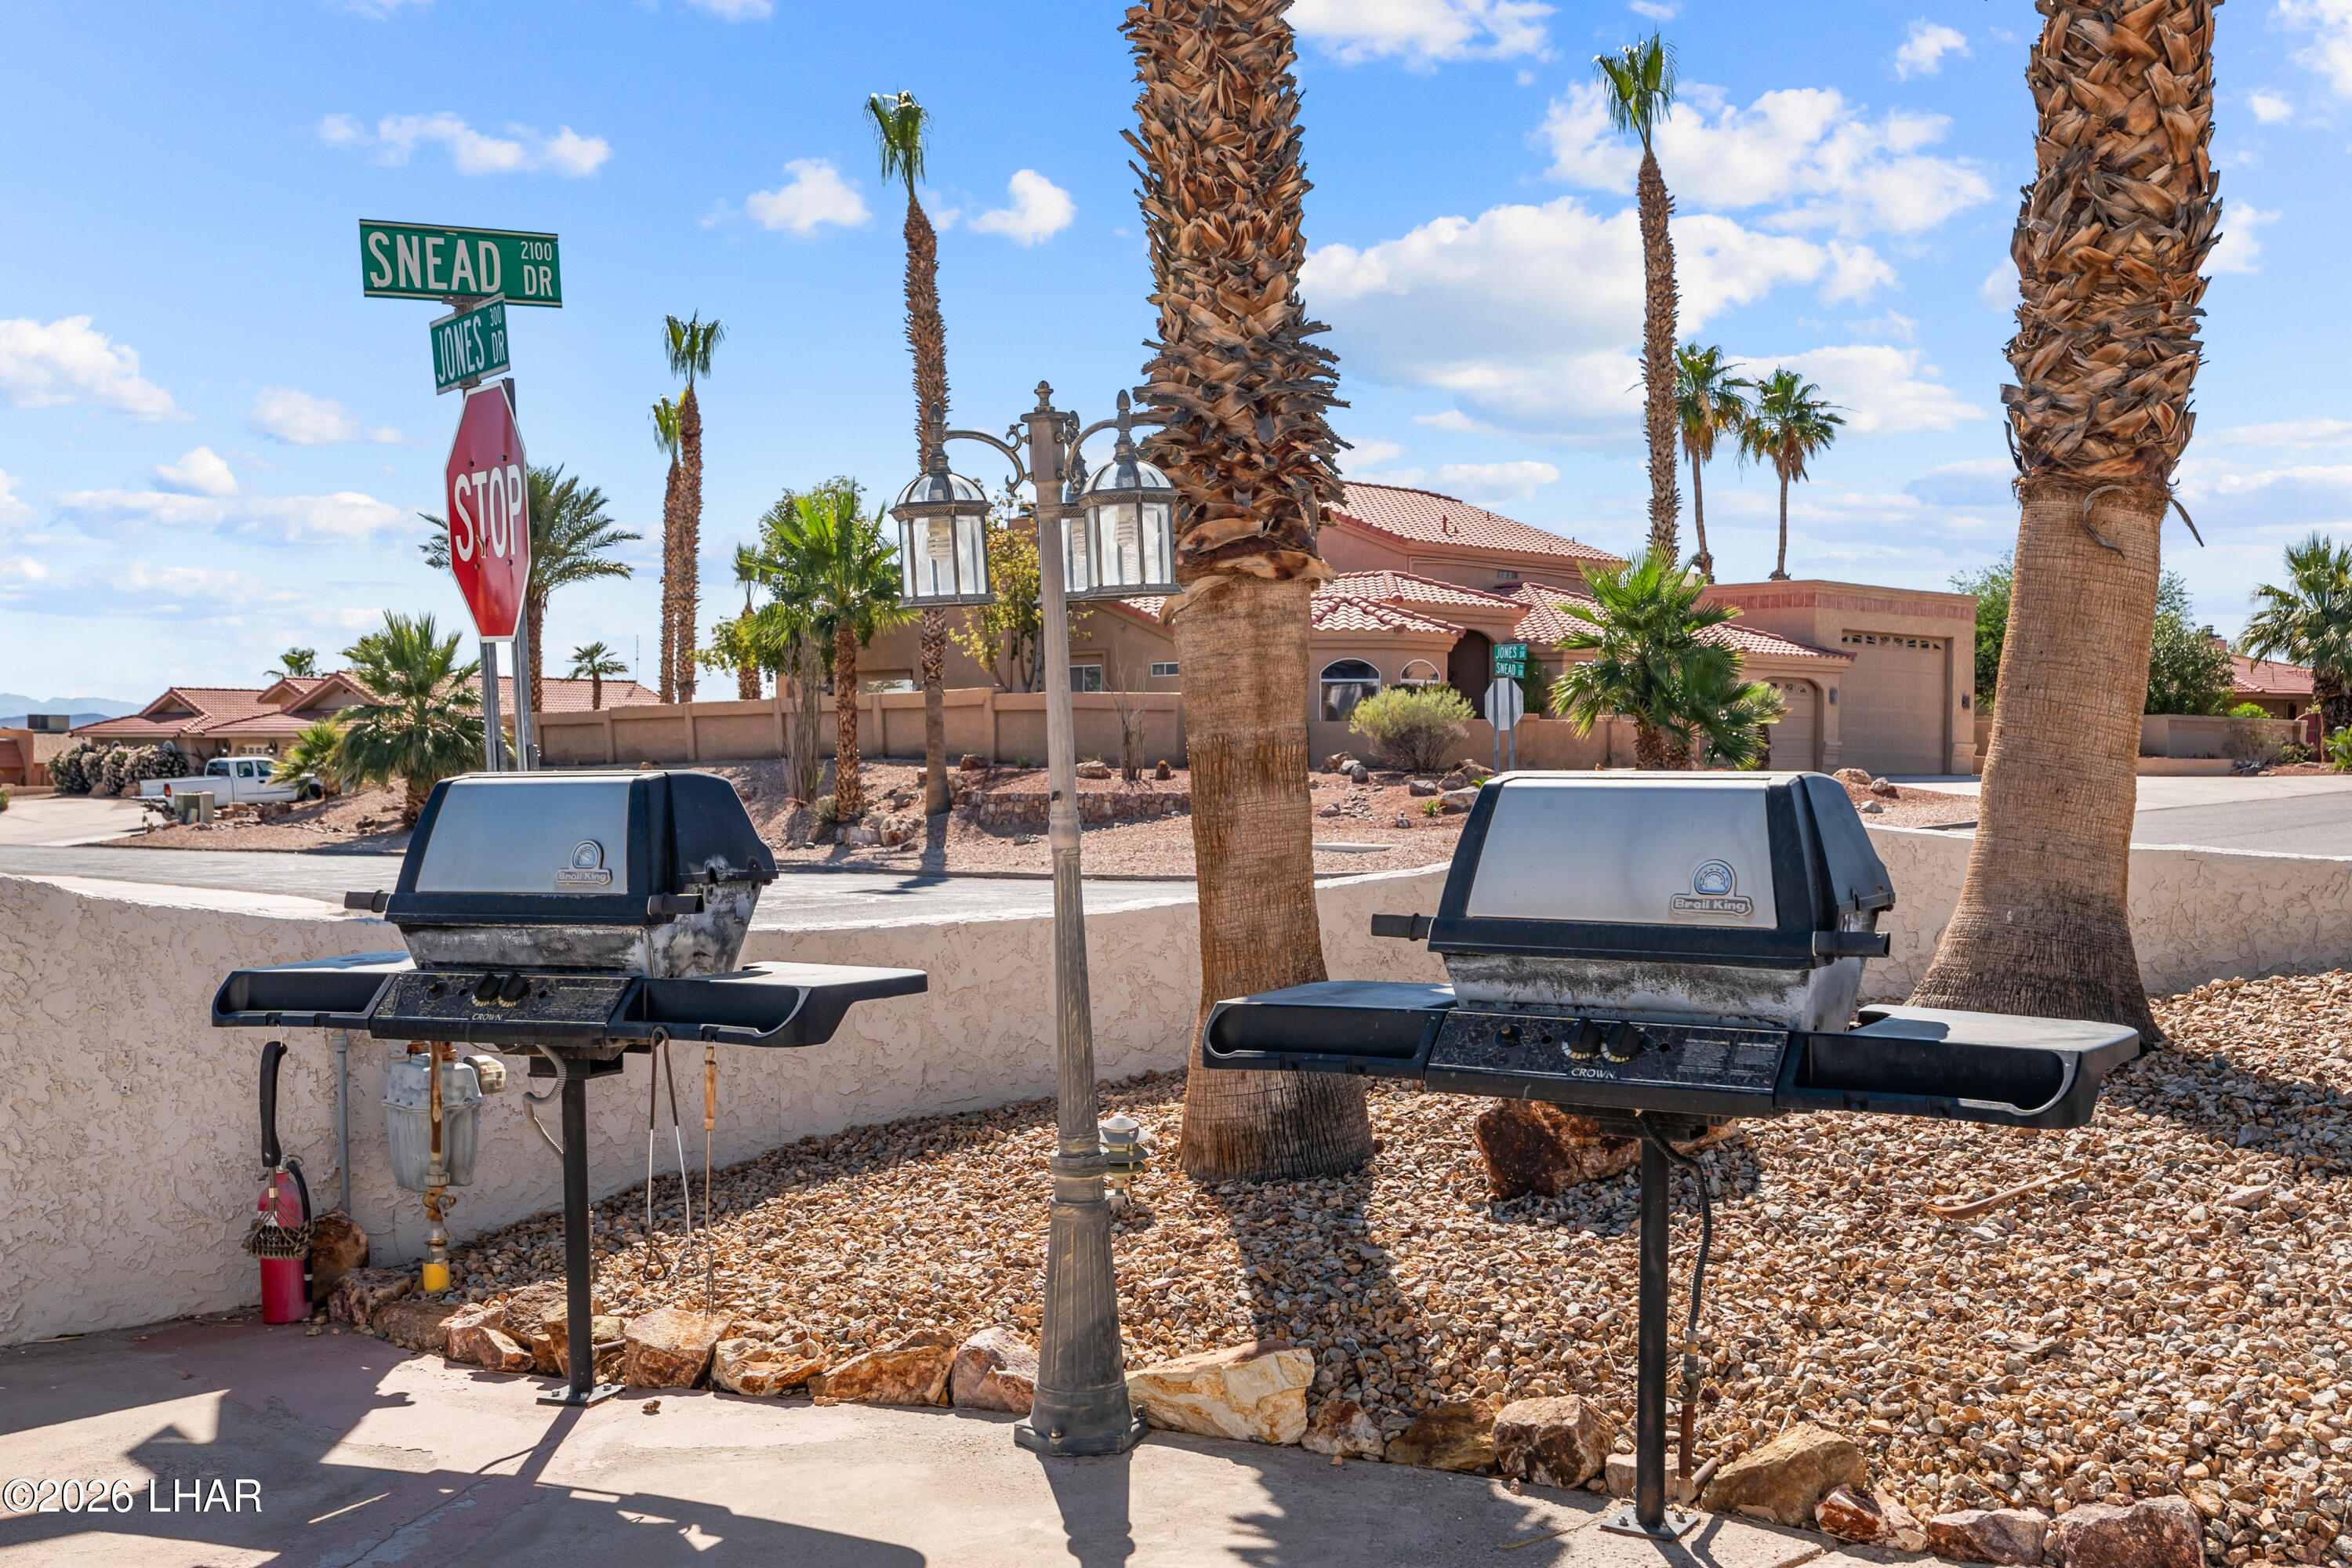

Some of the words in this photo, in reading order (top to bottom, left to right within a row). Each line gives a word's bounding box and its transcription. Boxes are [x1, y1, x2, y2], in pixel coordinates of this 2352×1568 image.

[520, 241, 553, 261] 2100
[368, 231, 502, 293] SNEAD
[523, 264, 554, 297] DR
[489, 305, 502, 327] 300
[437, 315, 485, 384] JONES
[491, 329, 506, 364] DR
[454, 463, 523, 562] STOP
[1495, 646, 1517, 659] JONES
[1496, 662, 1516, 676] SNEAD
[558, 872, 582, 880] Broil
[584, 872, 607, 882] King
[1675, 898, 1709, 909] Broil
[1712, 899, 1747, 913] King
[1571, 1068, 1616, 1079] CROWN
